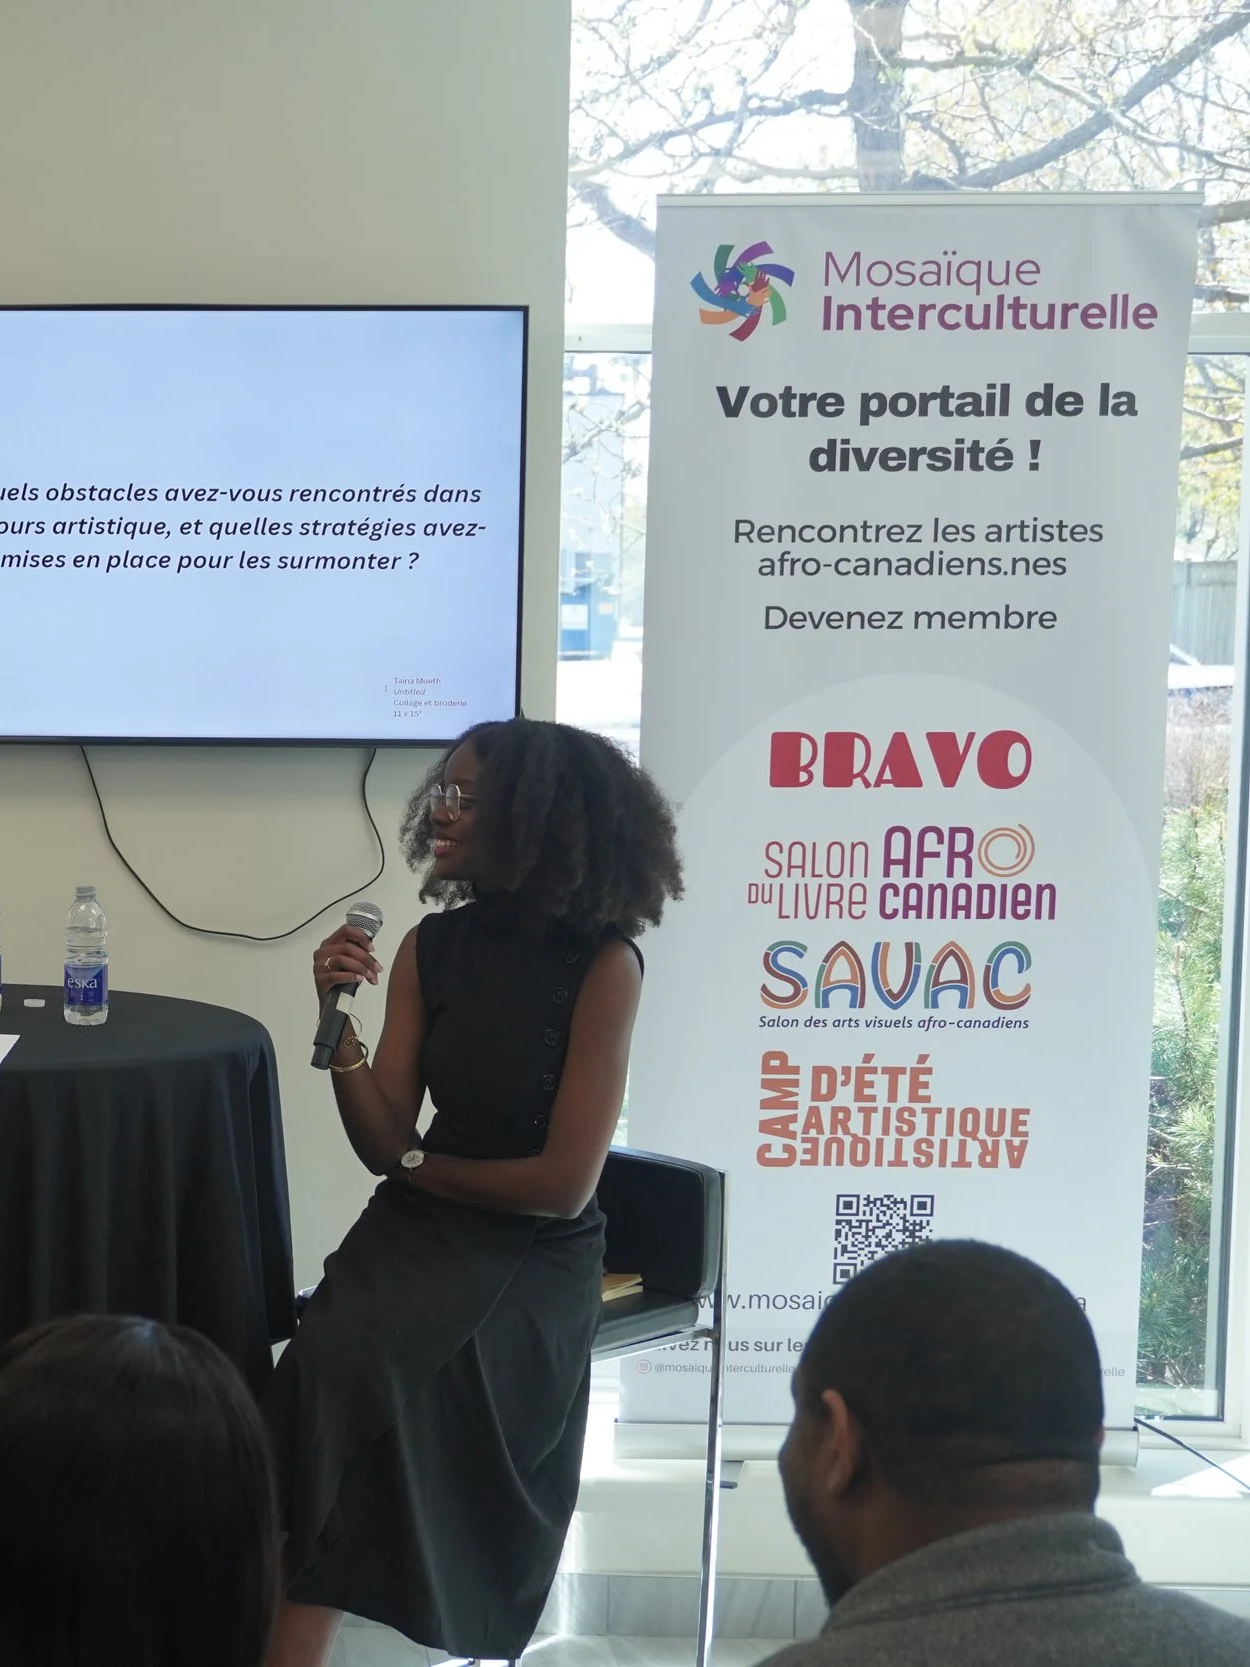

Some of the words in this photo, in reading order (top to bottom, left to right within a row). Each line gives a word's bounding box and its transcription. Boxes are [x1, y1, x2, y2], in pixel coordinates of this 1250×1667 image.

[823, 250, 1041, 295] Mosaïque
[821, 293, 1158, 331] Interculturelle
[715, 385, 845, 419] Votre
[859, 382, 1011, 427] portail
[1025, 382, 1084, 418] de
[1098, 382, 1139, 417] la
[808, 437, 1014, 473] diversité
[1027, 439, 1042, 472] !
[45, 482, 159, 502] obstacles
[164, 487, 283, 503] avez-vous
[289, 483, 417, 503] rencontrés
[423, 483, 482, 503] dans
[52, 516, 172, 540] artistique,
[179, 518, 204, 536] et
[209, 516, 294, 541] quelles
[298, 516, 417, 542] stratégies
[423, 521, 487, 537] avez-
[734, 519, 923, 544] Rencontrez
[933, 516, 976, 543] les
[984, 516, 1104, 543] artistes
[0, 549, 67, 569] mises
[72, 554, 100, 569] en
[105, 549, 171, 574] place
[176, 555, 234, 574] pour
[238, 550, 271, 570] les
[277, 553, 403, 571] surmonter
[408, 552, 420, 571] ?
[757, 549, 1067, 577] afro-canadiens.nes
[764, 605, 904, 630] Devenez
[913, 603, 1058, 630] membre
[393, 677, 414, 685] Taina
[393, 688, 427, 696] Untitled
[393, 699, 423, 708] Collage
[393, 710, 401, 718] 11
[769, 729, 1033, 790] BRAVO
[747, 882, 774, 905] DU
[67, 977, 98, 989] eska
[759, 939, 1033, 1011] SAVAC
[758, 1015, 800, 1029] Salon
[803, 1015, 828, 1029] des
[832, 1016, 861, 1029] arts
[864, 1015, 913, 1030] visuels
[917, 1015, 1030, 1033] afro-canadiens
[810, 1052, 934, 1104] D'ÉTÉ
[756, 1050, 800, 1168] CAMP
[800, 1105, 1031, 1139] ARTISTIQUE
[704, 1339, 750, 1352] nus
[753, 1340, 783, 1352] sur
[787, 1338, 806, 1352] le
